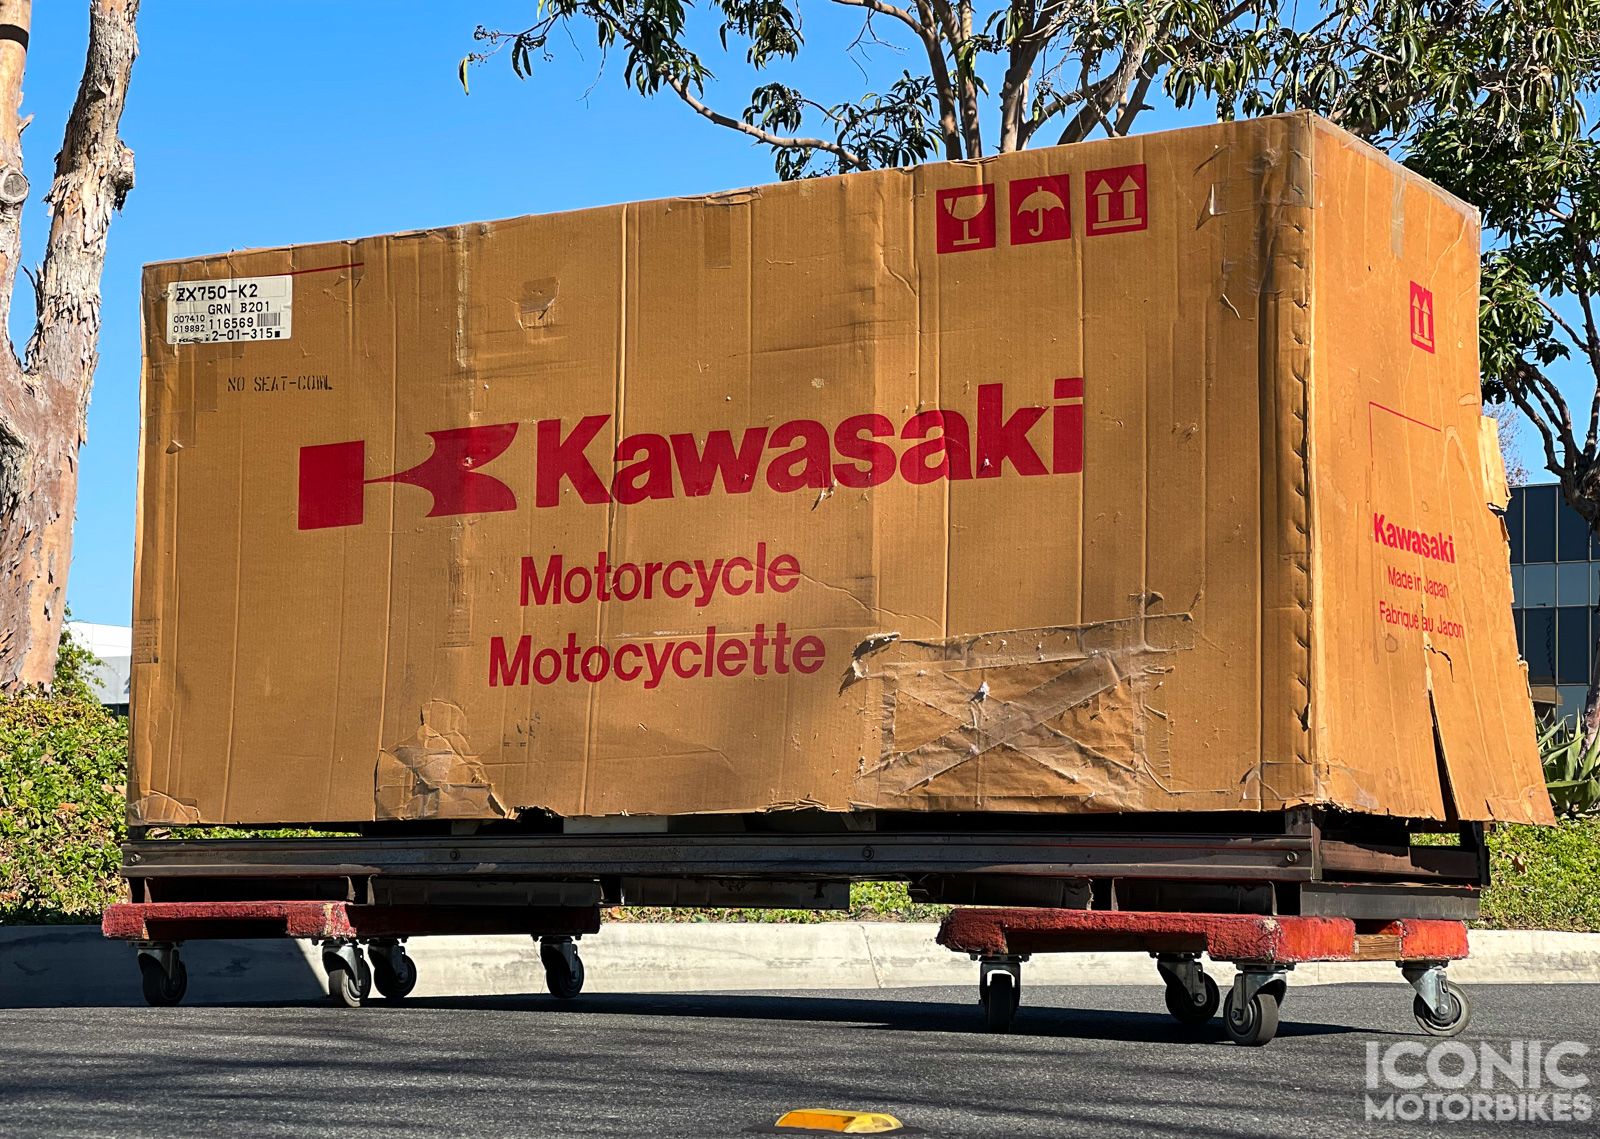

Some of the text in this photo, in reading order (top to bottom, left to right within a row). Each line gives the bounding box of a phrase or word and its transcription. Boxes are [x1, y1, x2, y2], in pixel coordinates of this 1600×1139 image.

[176, 284, 258, 302] ZX750-K2
[173, 314, 206, 323] 007410
[208, 301, 270, 315] GRN B201
[173, 324, 206, 333] 019892
[209, 317, 254, 331] 116569
[227, 376, 245, 392] NO
[536, 378, 1084, 507] Kawasaki
[1374, 512, 1455, 563] Kawasaki
[520, 542, 800, 607] Motorcycle
[1387, 565, 1449, 599] Made in Japan
[1379, 600, 1465, 639] Fabrique au Japon
[489, 623, 825, 688] Motocyclette
